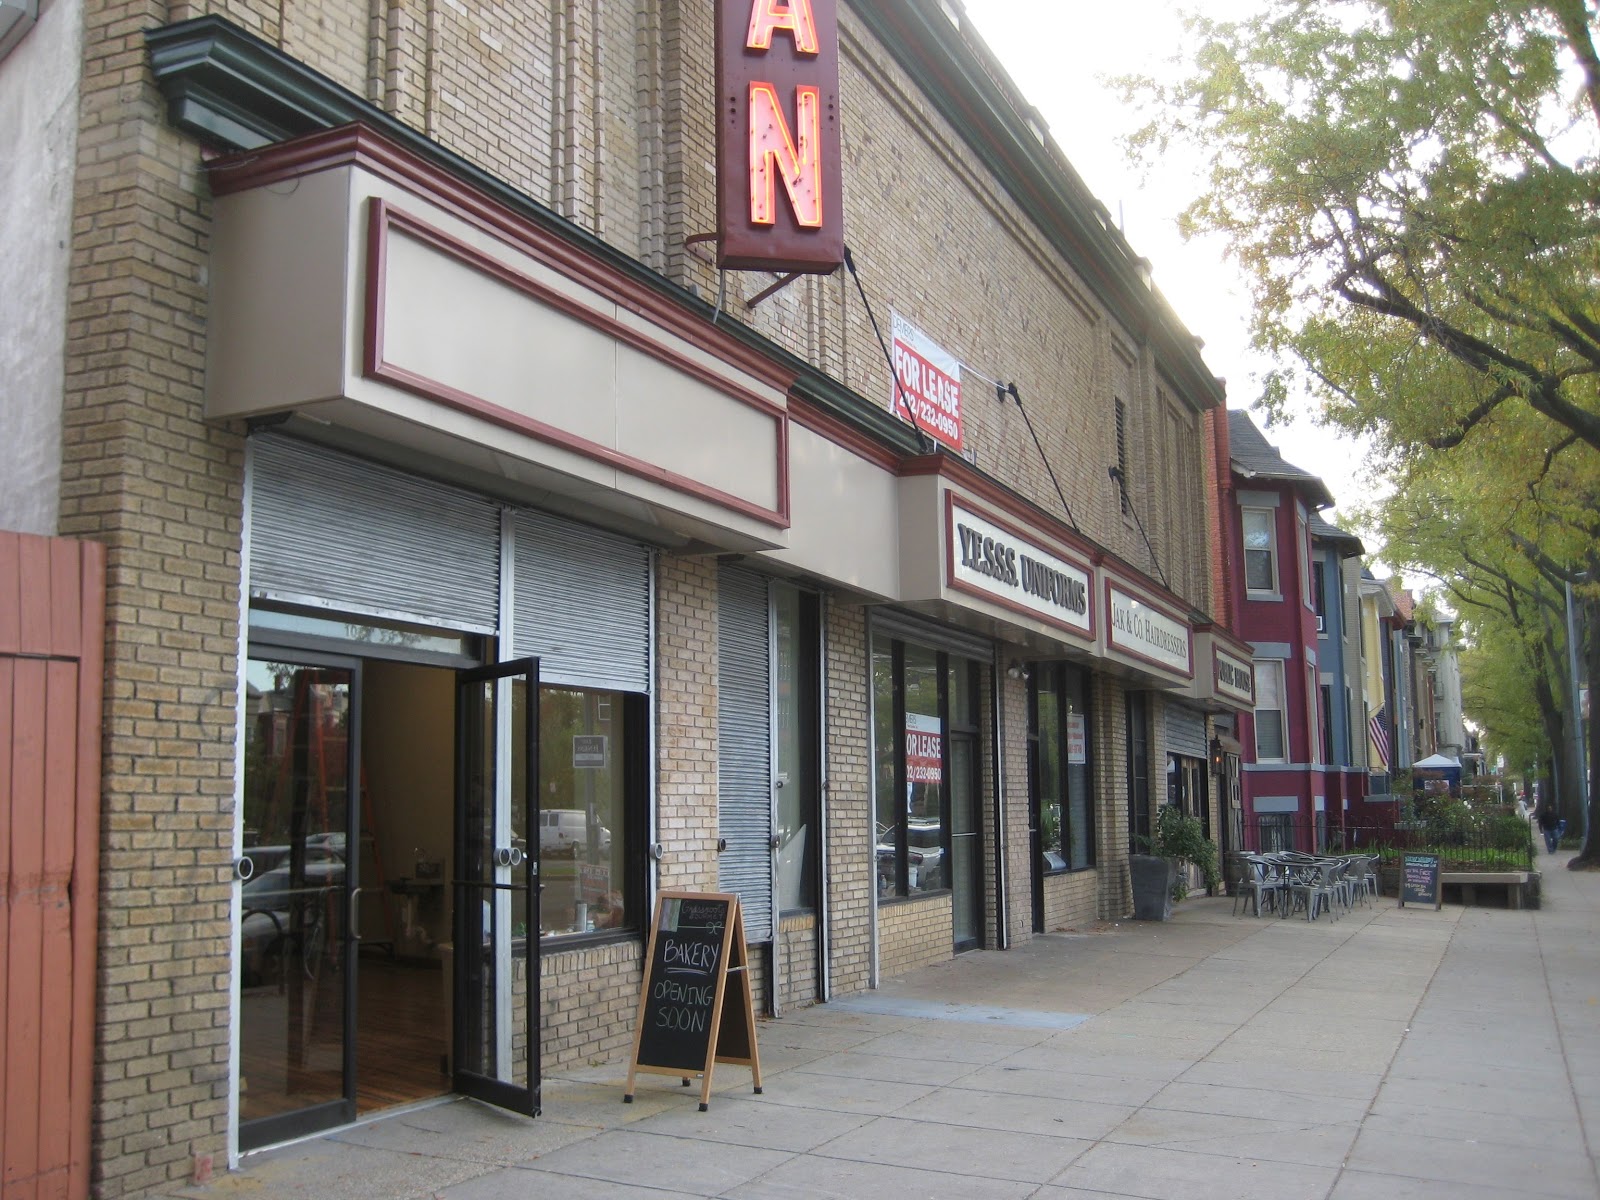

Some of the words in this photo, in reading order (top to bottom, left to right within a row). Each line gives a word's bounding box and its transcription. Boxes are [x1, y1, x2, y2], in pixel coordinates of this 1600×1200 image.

[895, 344, 921, 394] FOR
[921, 363, 960, 419] LEASE
[1020, 554, 1086, 616] UNIFORMS
[906, 733, 917, 756] OR
[918, 735, 942, 759] LEASE
[663, 938, 720, 973] BAKERY
[654, 979, 714, 1006] OPENING
[655, 1006, 706, 1032] SOON
